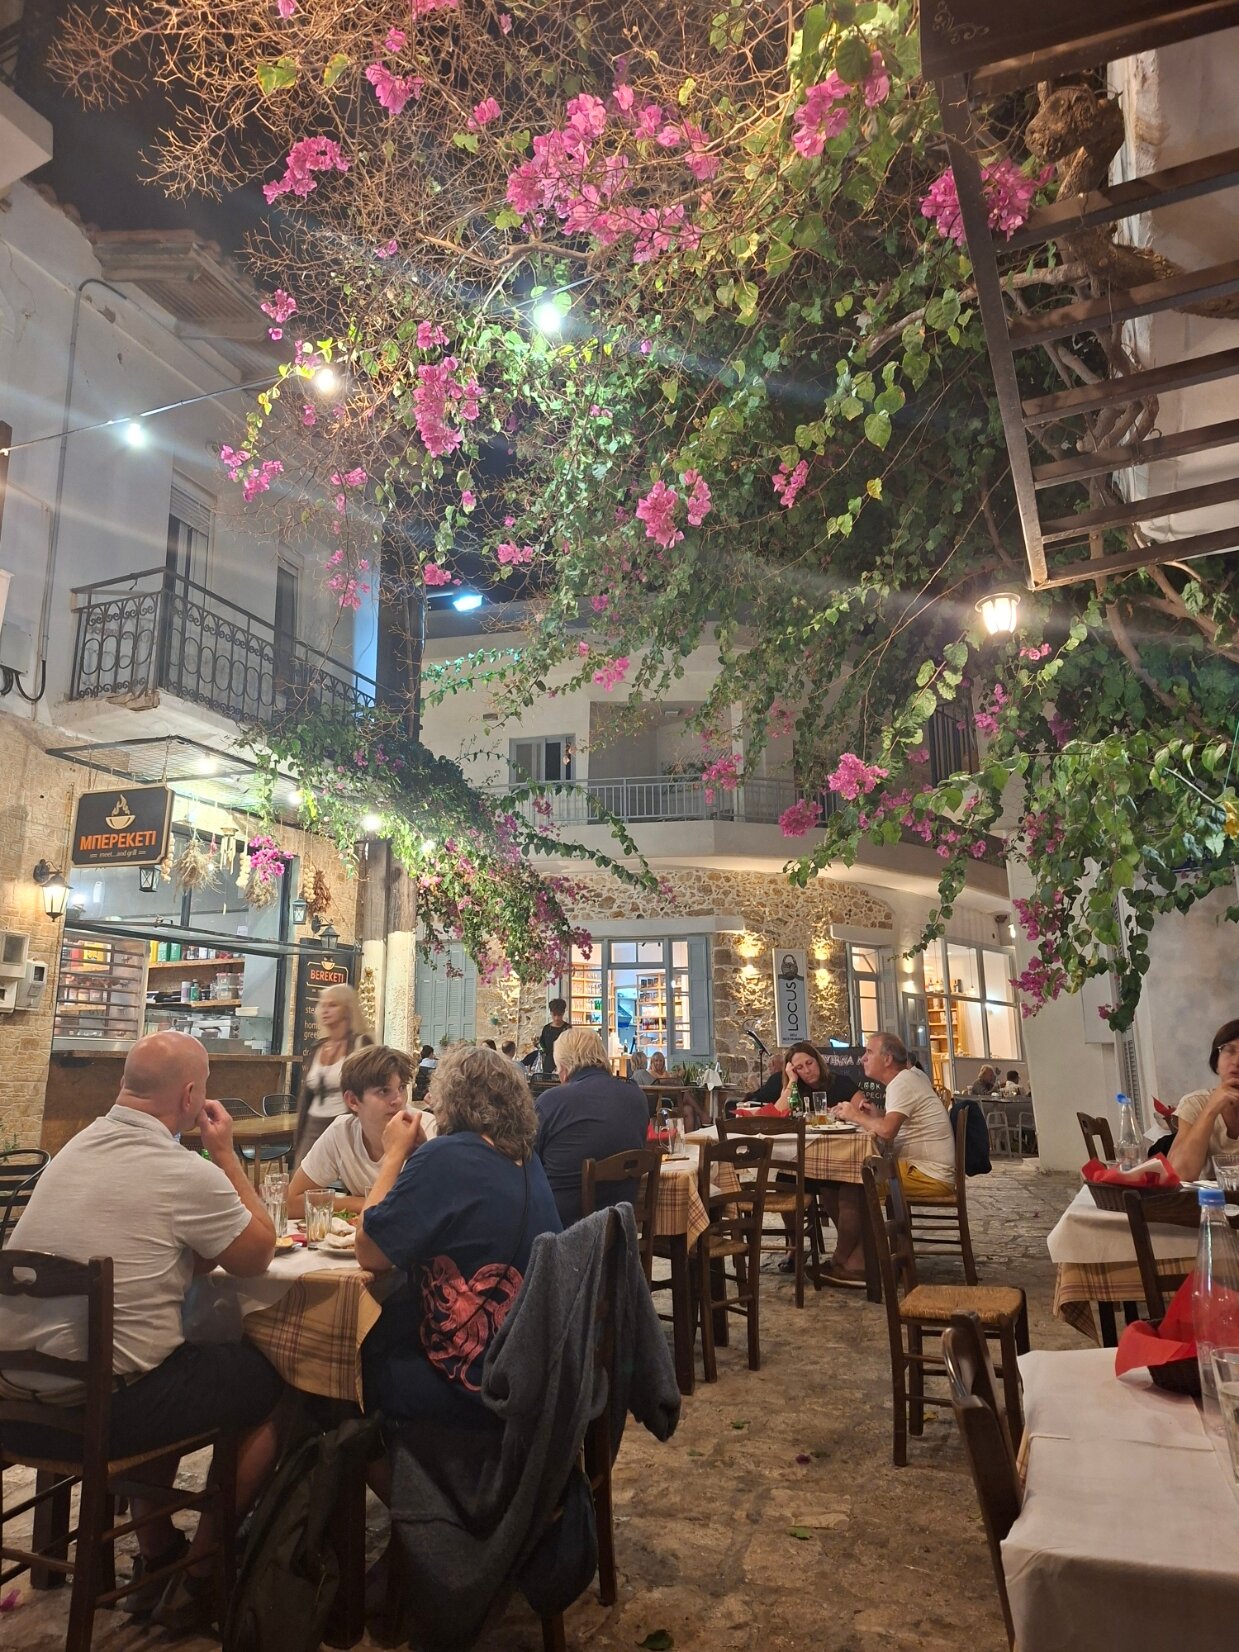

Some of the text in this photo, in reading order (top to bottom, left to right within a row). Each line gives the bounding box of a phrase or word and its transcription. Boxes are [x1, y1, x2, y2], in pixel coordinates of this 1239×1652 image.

[80, 831, 157, 851] ΜΠΕΡΕΚΕΤΙ
[310, 969, 344, 983] BEREKETI
[786, 981, 799, 1031] LOCUS
